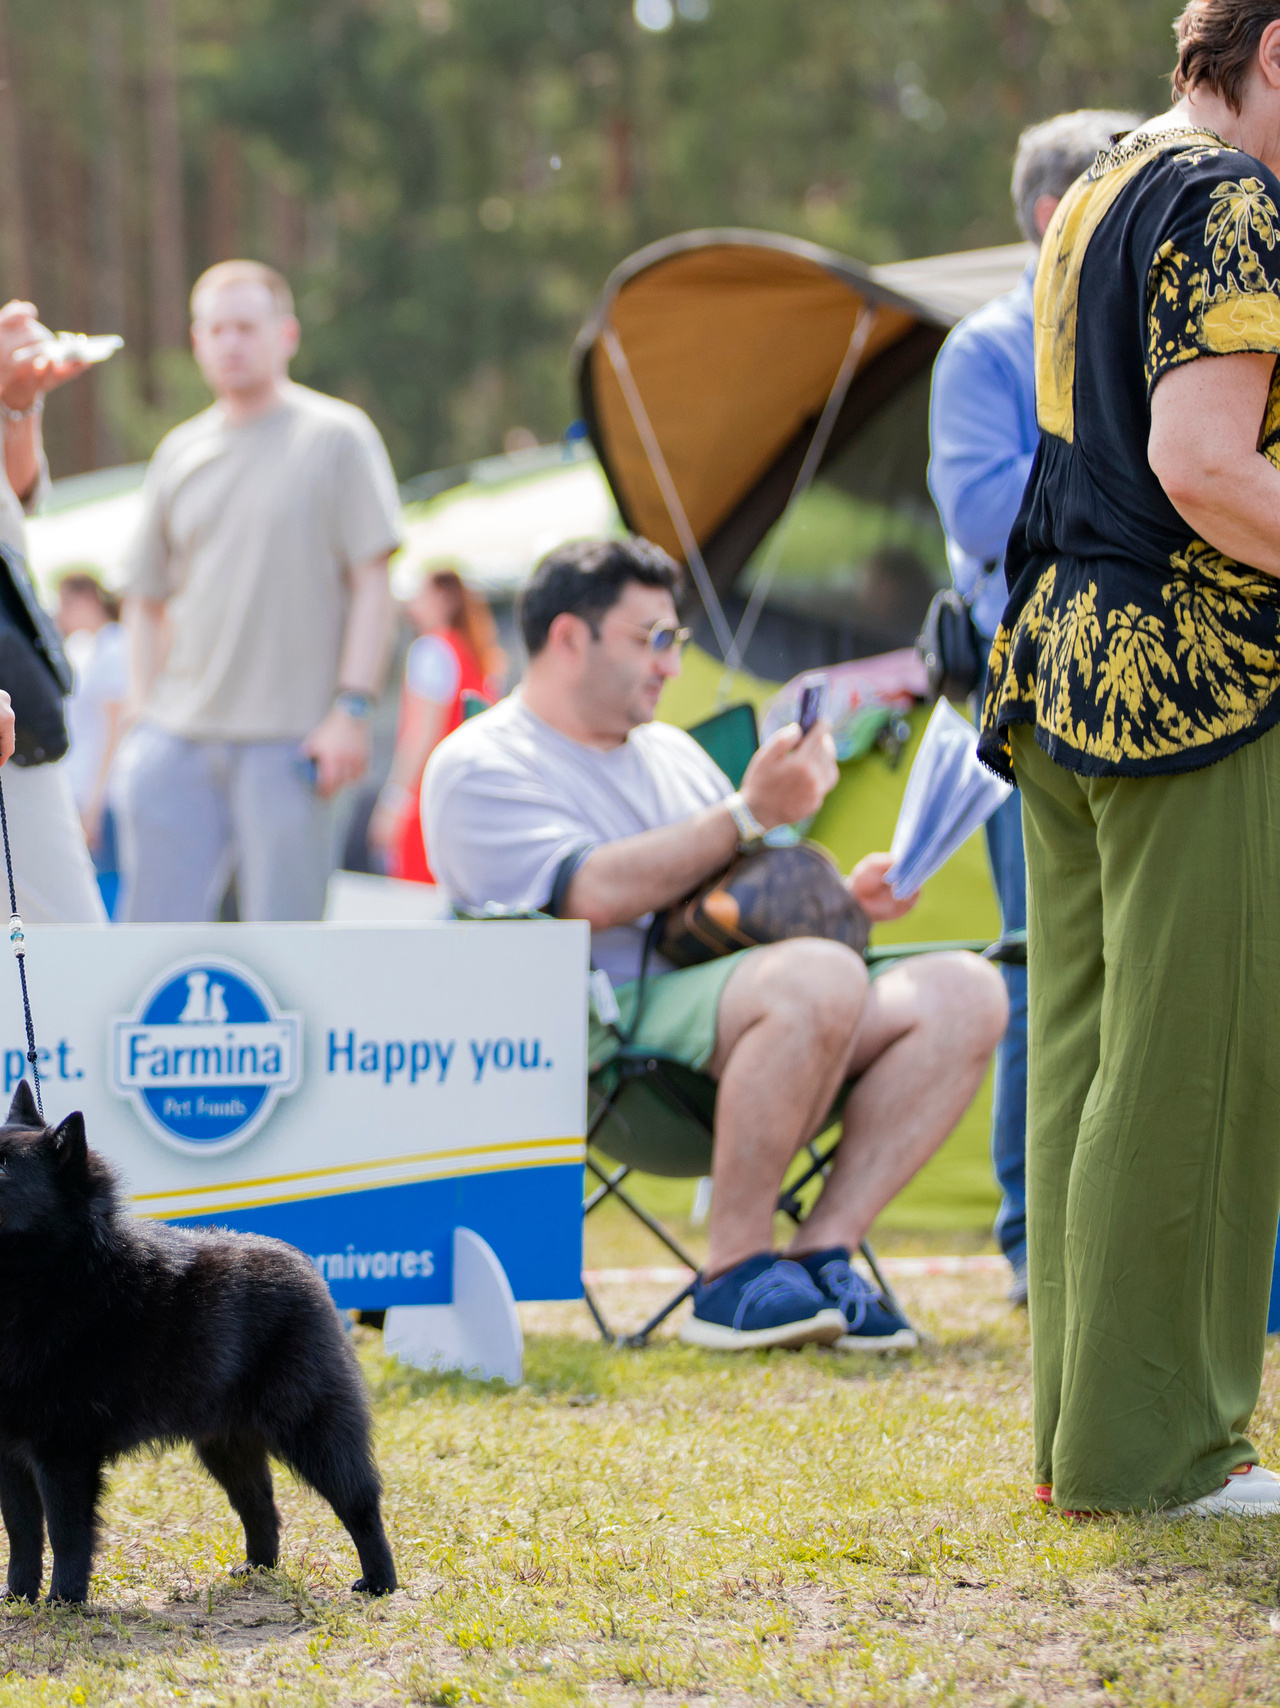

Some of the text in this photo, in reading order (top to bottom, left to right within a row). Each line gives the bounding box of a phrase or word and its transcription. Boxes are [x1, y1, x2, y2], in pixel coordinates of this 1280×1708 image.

[129, 1032, 282, 1077] Farmina
[327, 1029, 553, 1085] Happy you.
[163, 1095, 247, 1117] Pet Foods
[308, 1244, 435, 1280] rnivores
